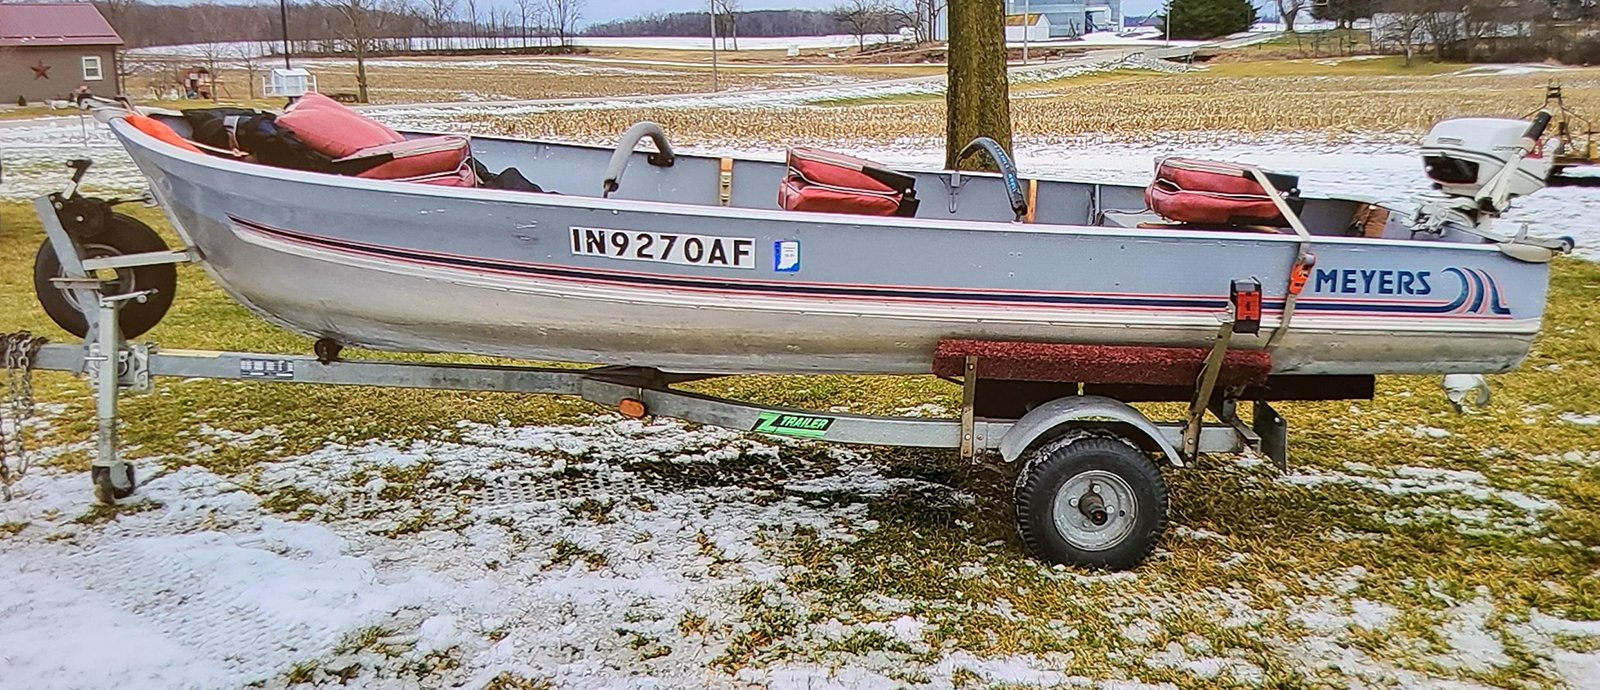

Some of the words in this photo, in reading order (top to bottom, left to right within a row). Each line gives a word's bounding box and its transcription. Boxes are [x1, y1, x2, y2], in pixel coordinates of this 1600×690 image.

[572, 228, 752, 266] IN9270AF
[1315, 269, 1431, 295] MEYERS
[754, 411, 781, 433] Z
[780, 415, 829, 430] TRAILER
